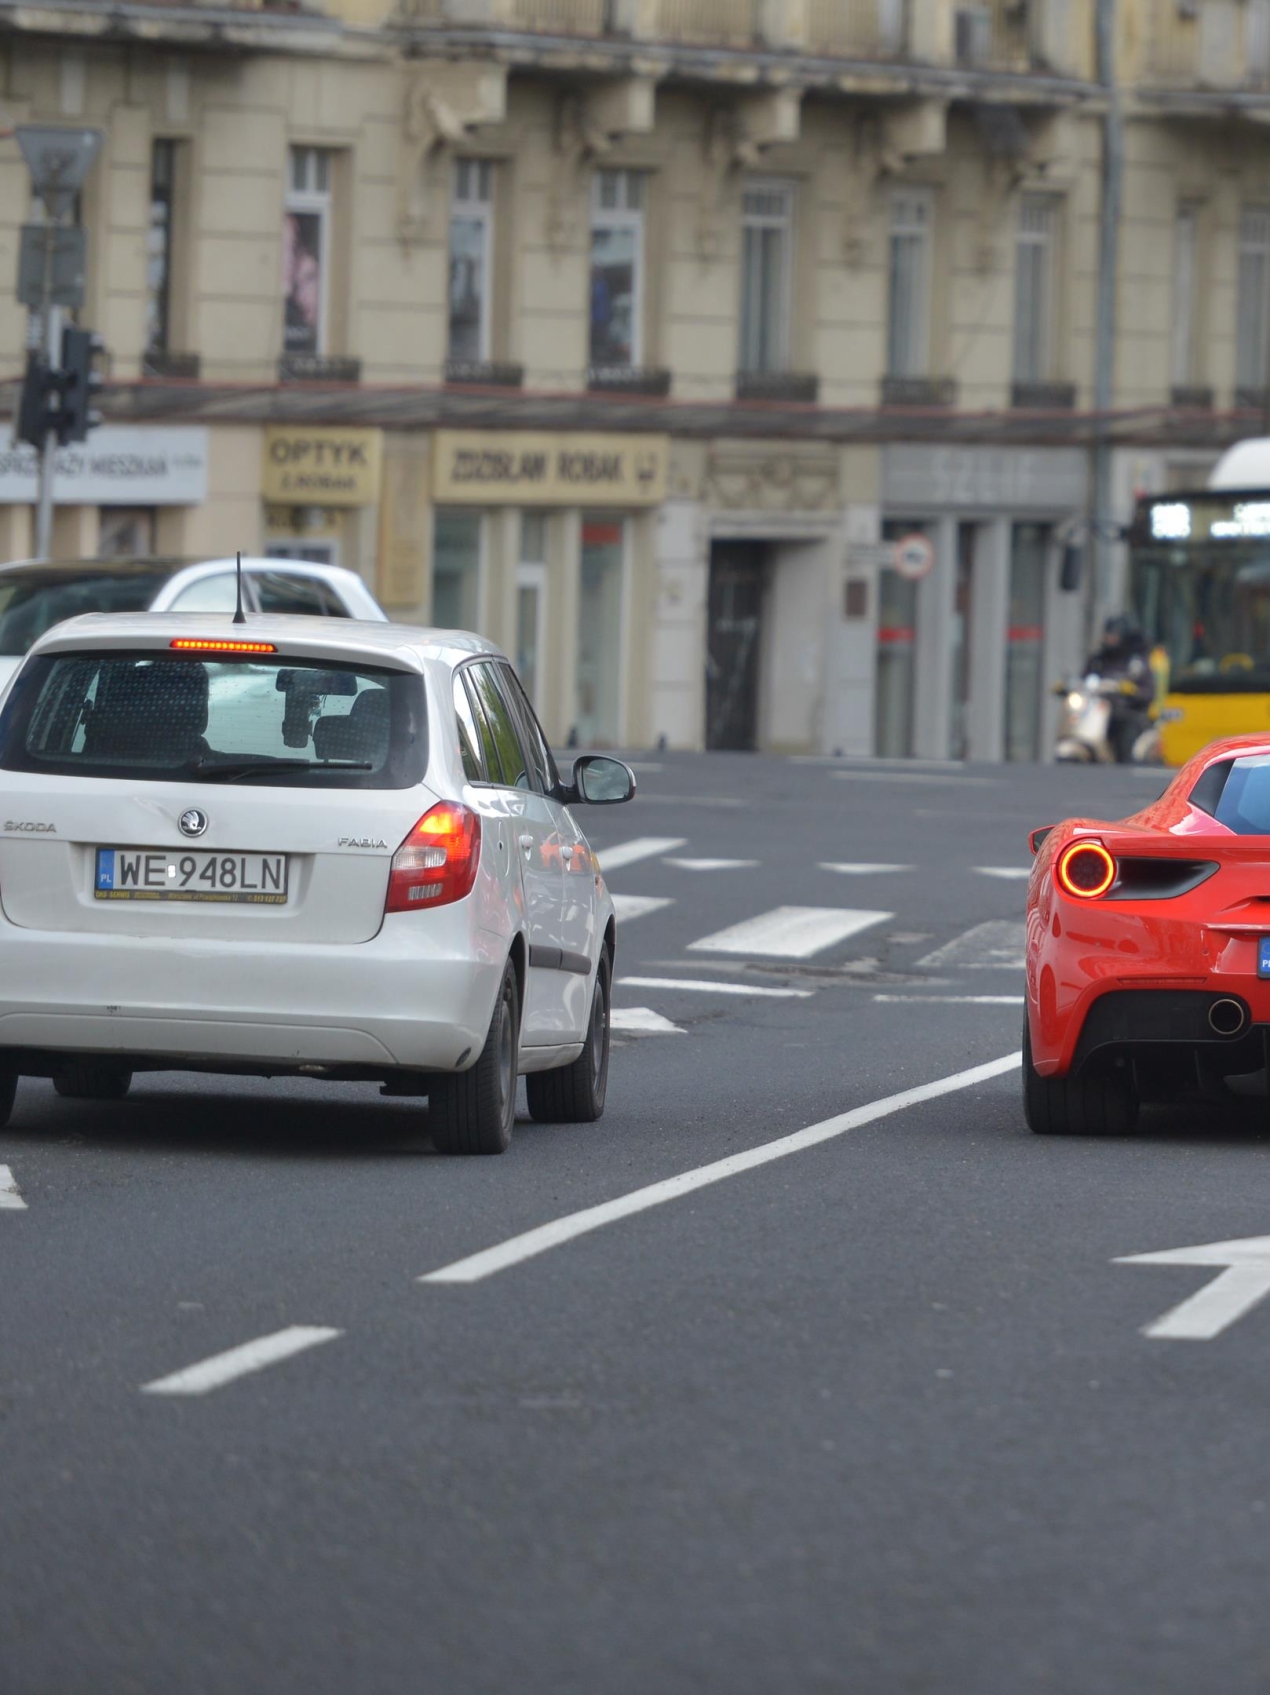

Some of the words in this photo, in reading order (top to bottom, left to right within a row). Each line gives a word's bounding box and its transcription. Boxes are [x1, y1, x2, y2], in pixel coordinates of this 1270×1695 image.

[270, 438, 366, 466] OPTYK
[337, 837, 388, 848] FABIA
[101, 874, 112, 883] PL
[120, 854, 166, 886] WE
[179, 855, 281, 889] 948LN
